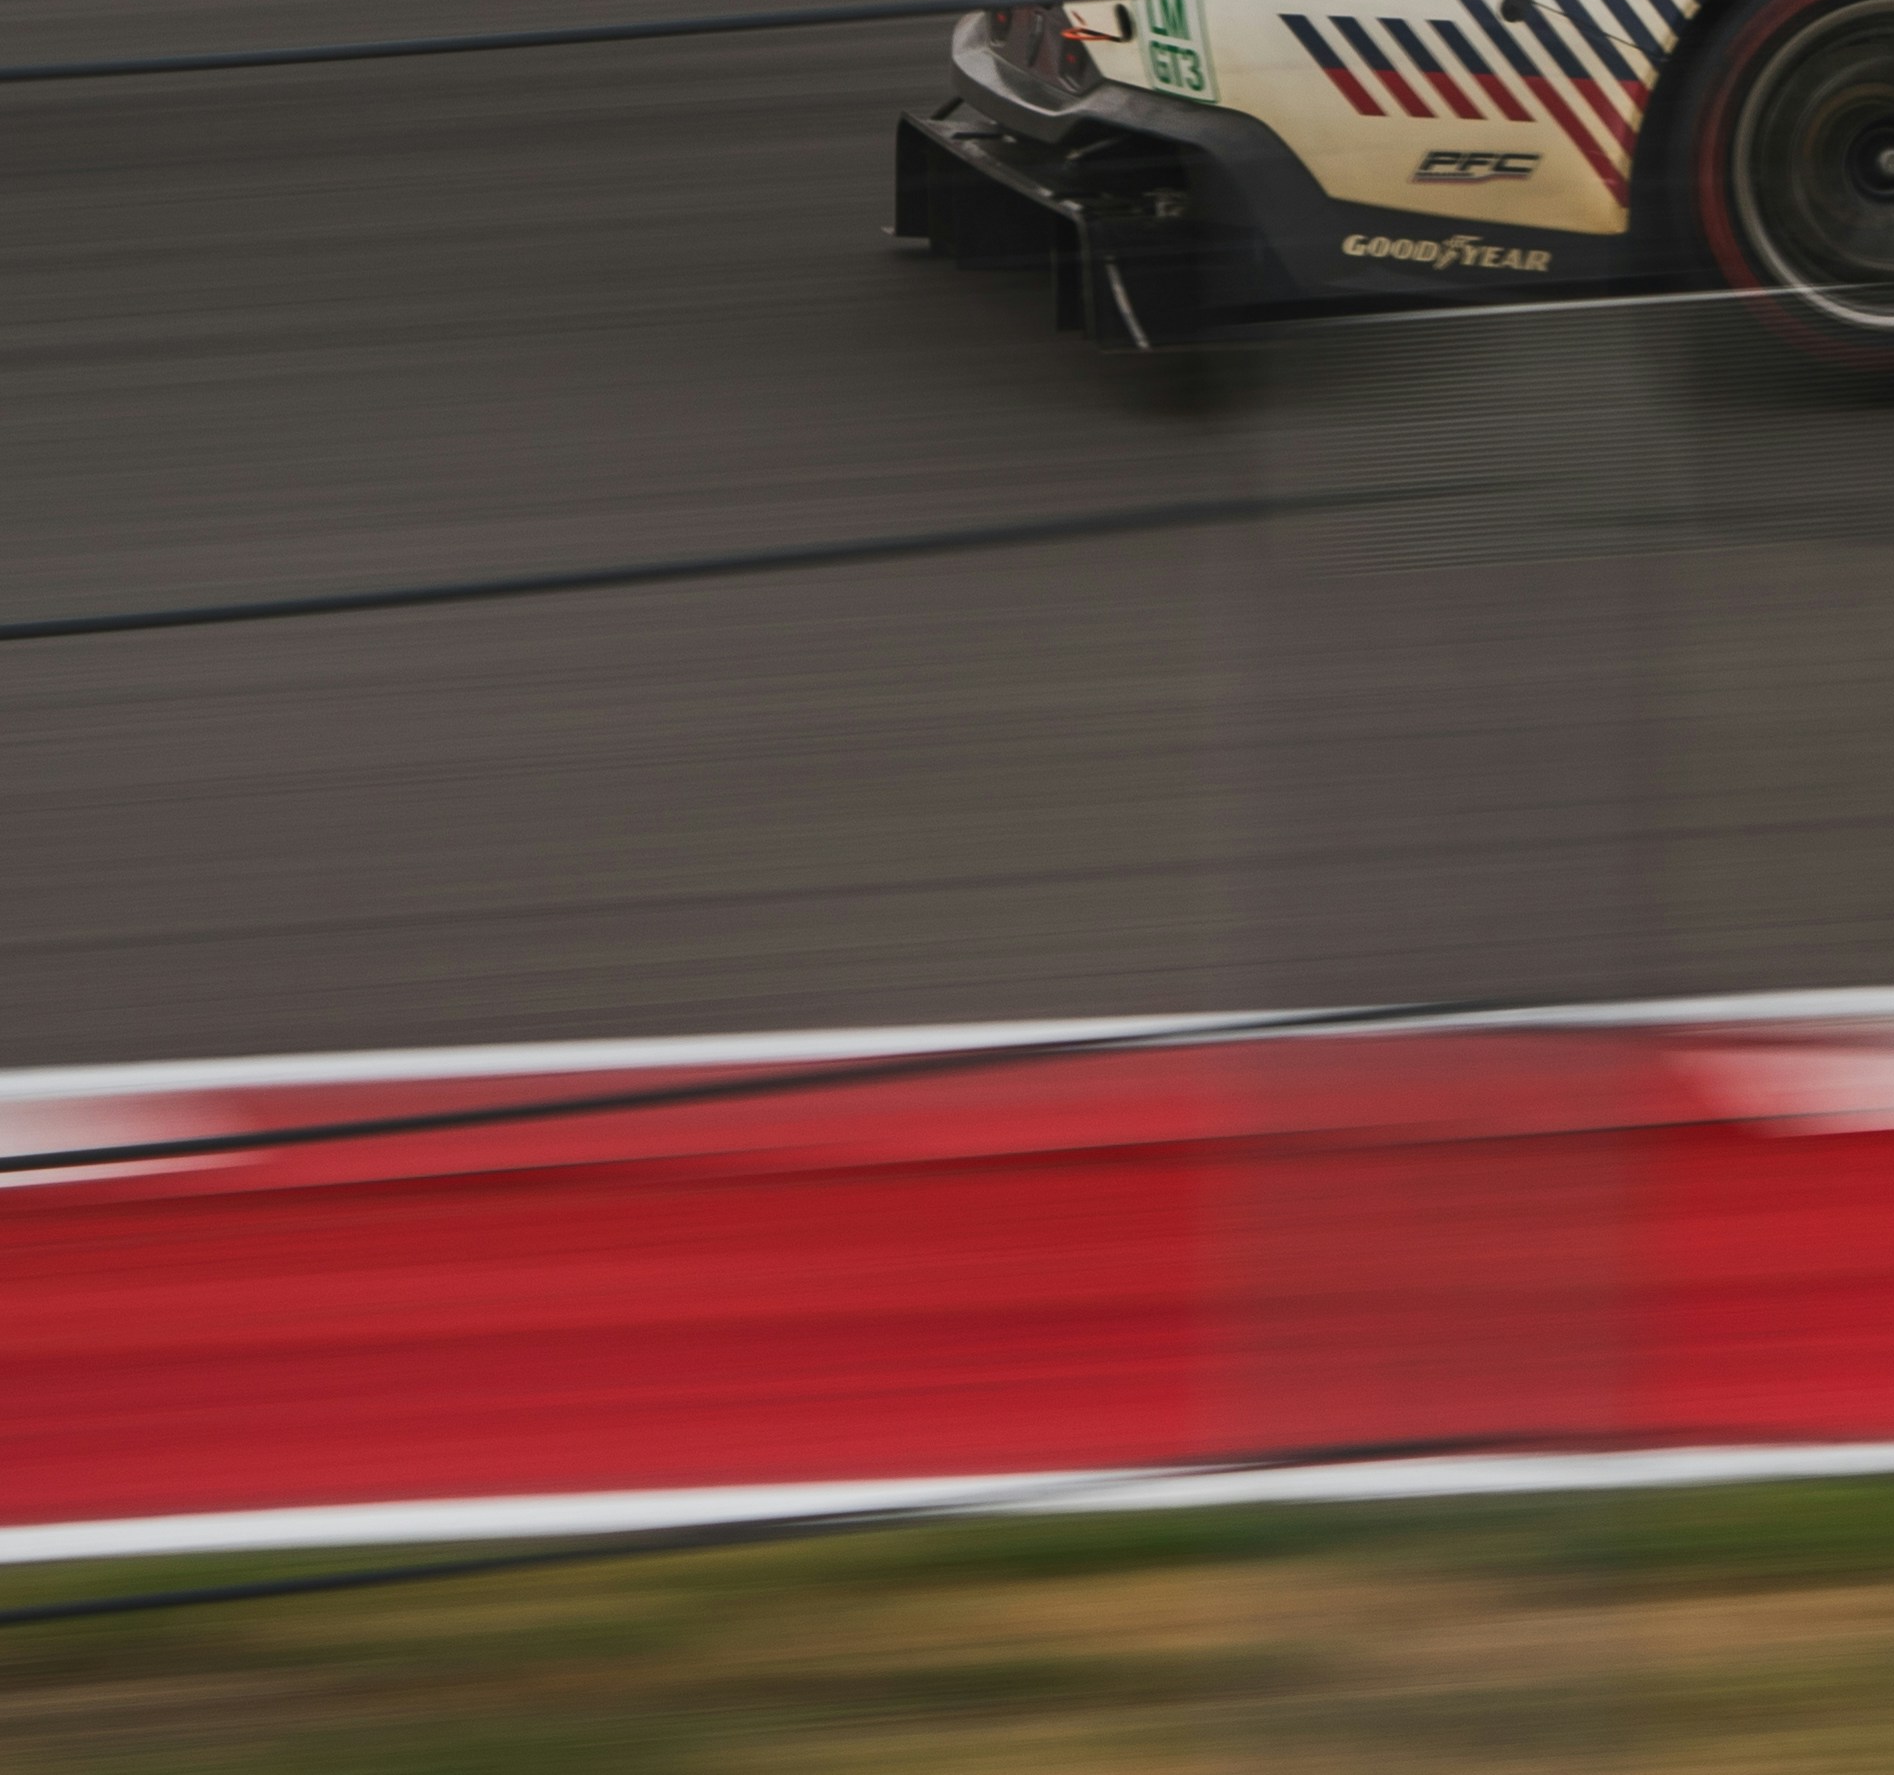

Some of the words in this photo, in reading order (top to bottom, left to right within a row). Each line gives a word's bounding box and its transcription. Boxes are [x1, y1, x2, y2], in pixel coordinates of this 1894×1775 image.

[1148, 40, 1205, 92] GT3
[1415, 150, 1543, 174] PFC
[1340, 233, 1553, 272] GOODYEAR
